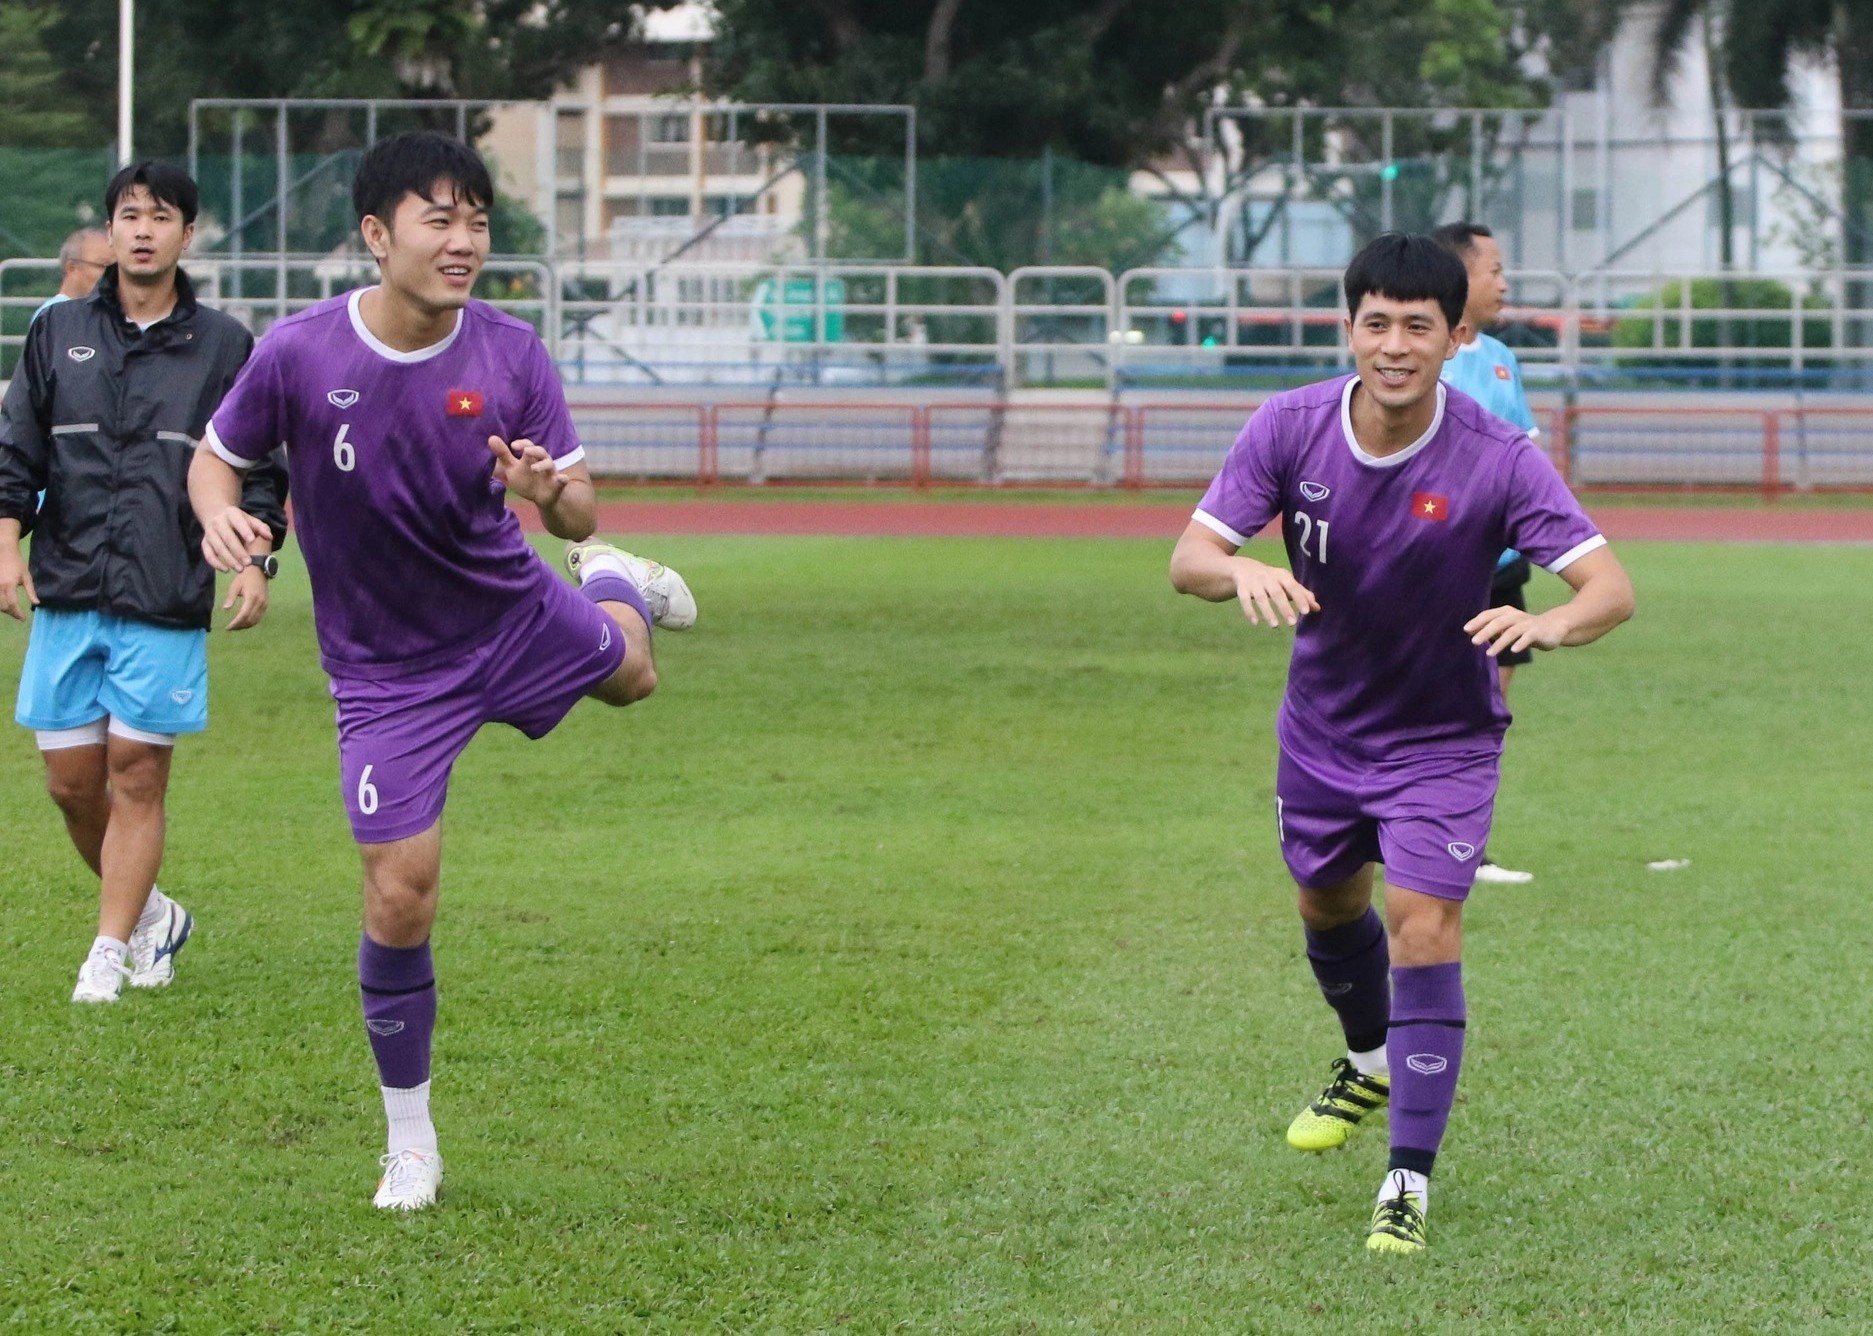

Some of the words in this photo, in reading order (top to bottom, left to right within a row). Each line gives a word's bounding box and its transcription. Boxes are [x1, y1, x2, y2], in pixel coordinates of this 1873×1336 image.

[333, 423, 356, 472] 6
[1294, 510, 1330, 564] 21
[358, 764, 379, 815] 6
